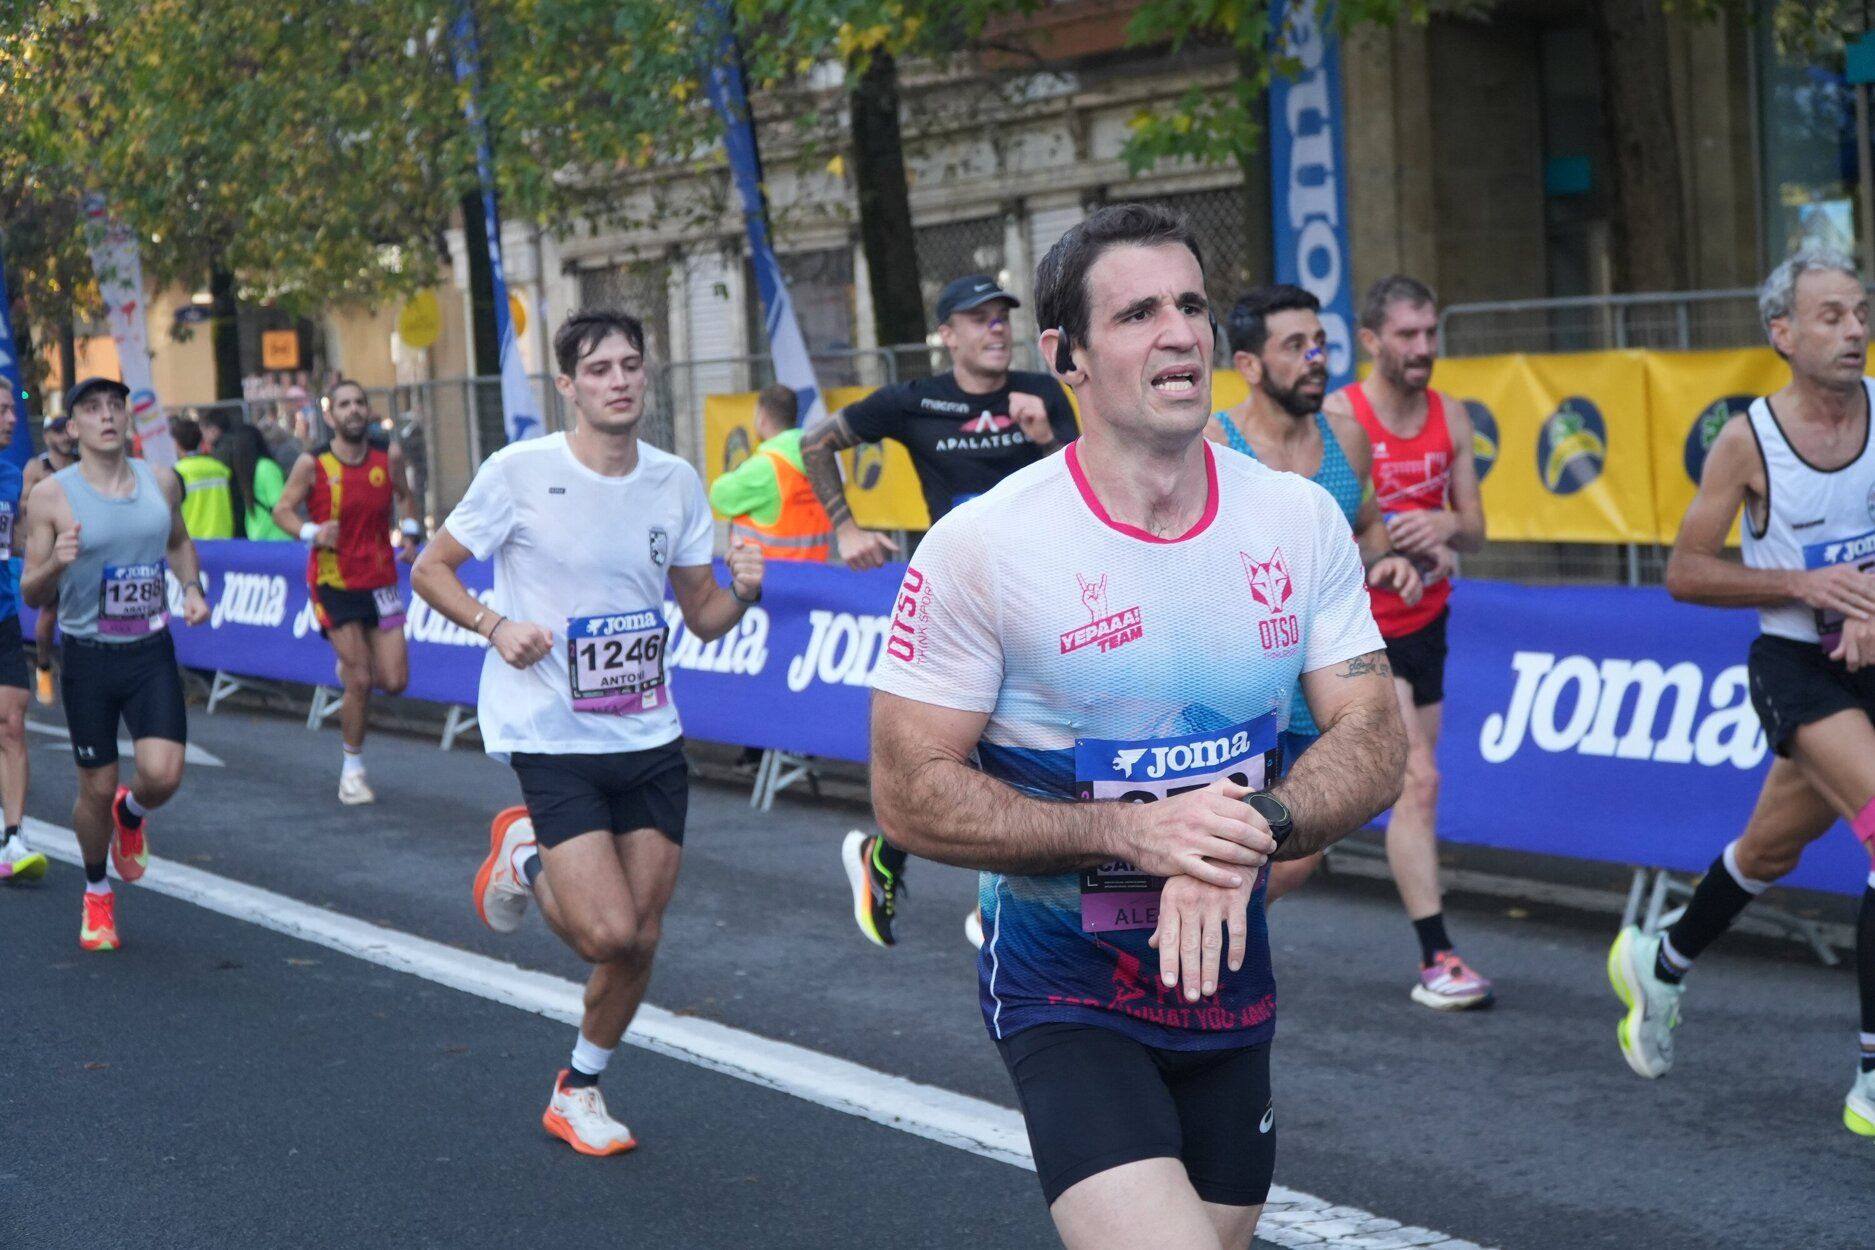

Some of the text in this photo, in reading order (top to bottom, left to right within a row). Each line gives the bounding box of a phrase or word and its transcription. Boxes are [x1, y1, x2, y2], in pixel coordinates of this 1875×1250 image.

[936, 434, 1034, 451] APALATEG
[1097, 626, 1143, 653] TEAM
[1259, 615, 1299, 650] OTSO
[580, 634, 660, 671] 1246
[1115, 907, 1159, 925] ALE
[1193, 1007, 1235, 1030] YOU
